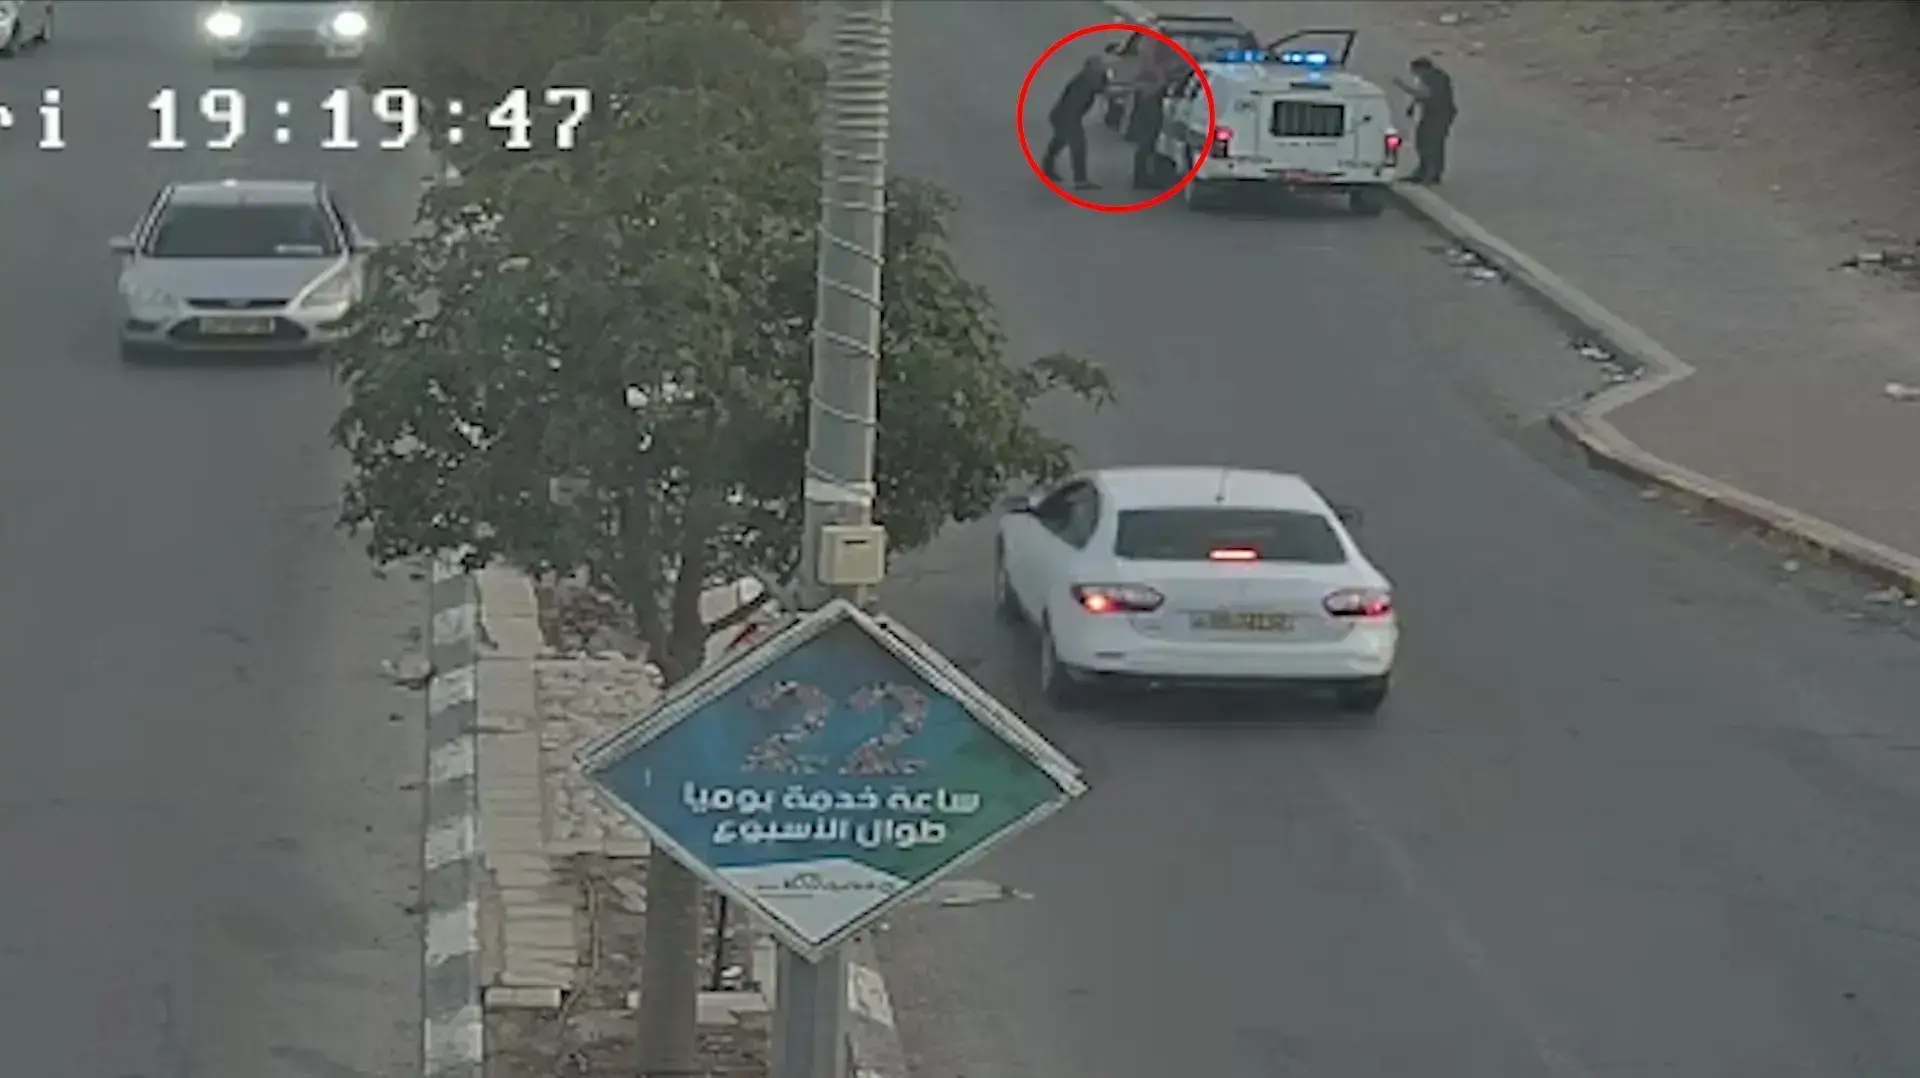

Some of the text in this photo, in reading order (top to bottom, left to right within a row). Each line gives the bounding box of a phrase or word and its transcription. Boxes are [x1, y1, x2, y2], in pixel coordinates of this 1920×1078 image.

[742, 681, 927, 776] 22
[782, 785, 879, 813] خدمة
[885, 785, 981, 814] ساعة
[855, 818, 947, 848] طوال
